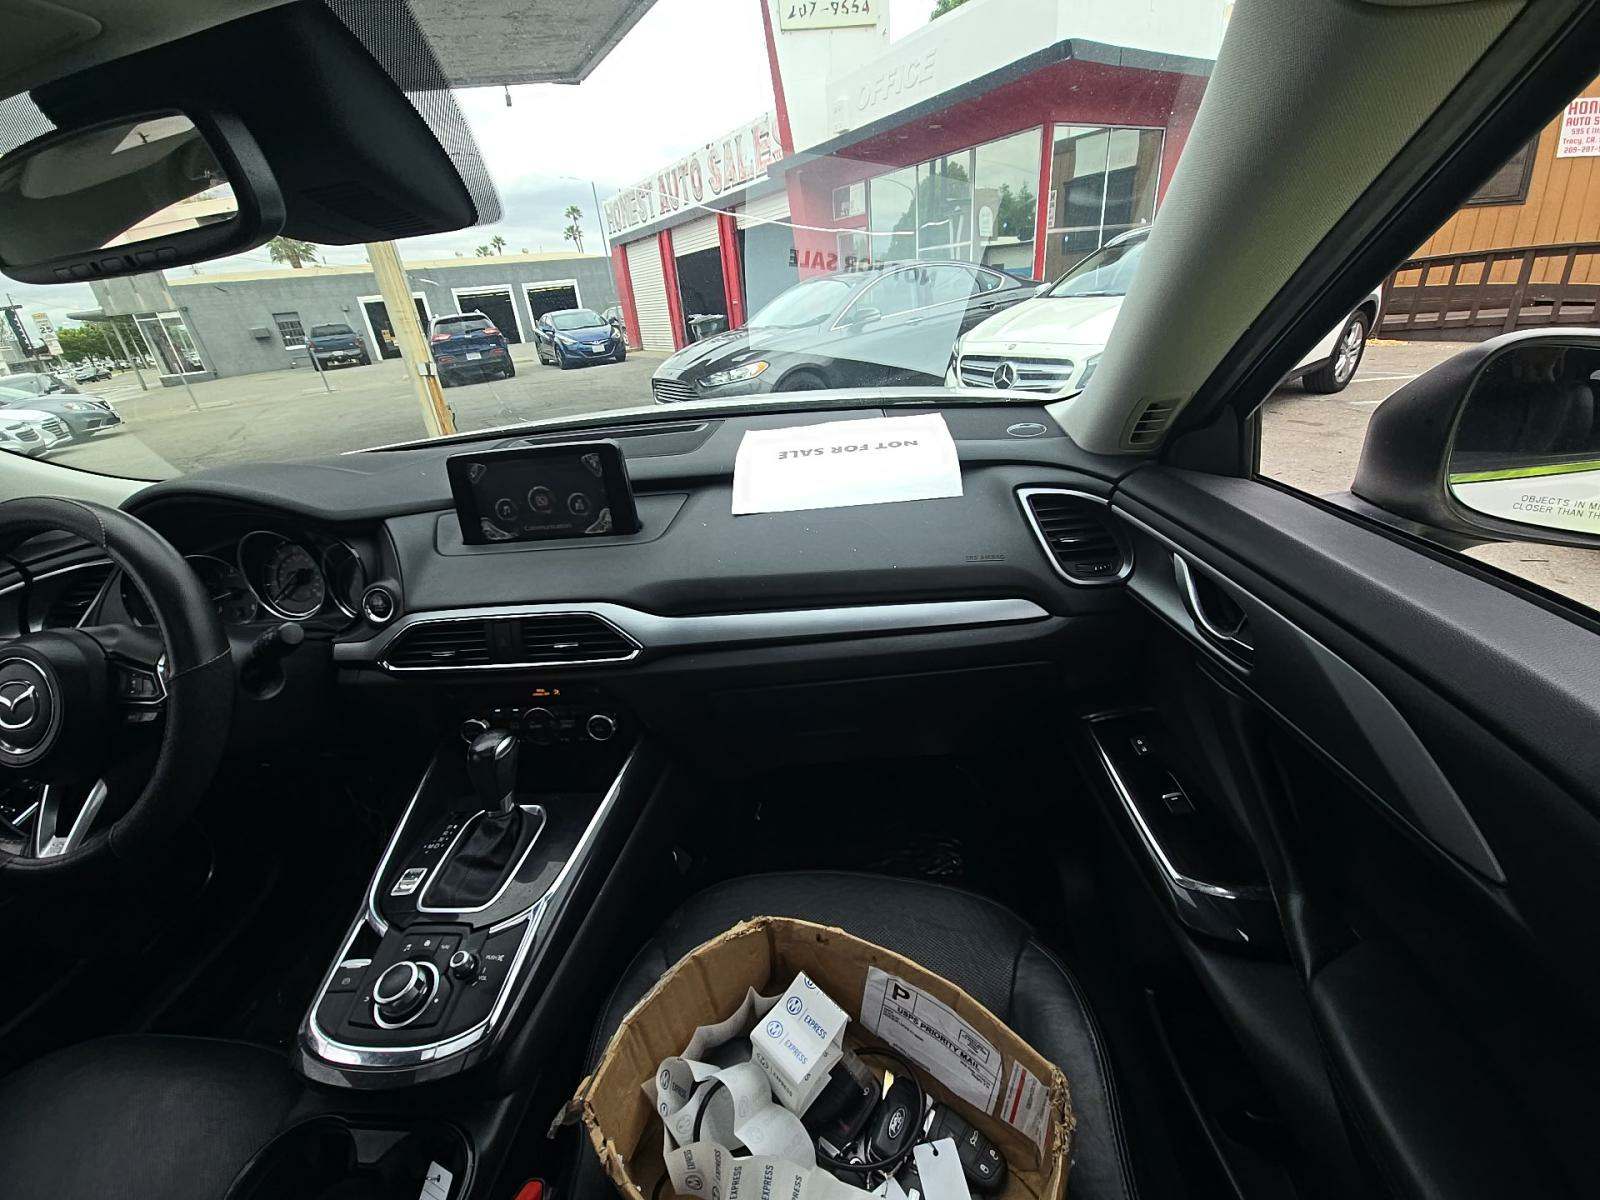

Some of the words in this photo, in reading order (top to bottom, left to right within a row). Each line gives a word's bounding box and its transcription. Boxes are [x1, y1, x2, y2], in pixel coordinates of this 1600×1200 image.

[857, 49, 937, 111] OFFICE
[1568, 100, 1600, 115] HON
[1566, 116, 1591, 127] AUTO
[604, 181, 656, 235] HONEST
[657, 157, 704, 214] AUTO
[778, 447, 824, 460] SALE
[831, 443, 869, 454] FOR
[875, 439, 919, 450] NOT
[1512, 502, 1553, 514] CLOSER
[1557, 507, 1584, 517] THAN
[1521, 494, 1570, 507] OBJECTS
[1574, 501, 1586, 509] IN
[892, 982, 910, 1001] P
[803, 1014, 828, 1040] EXPRESS
[897, 1006, 919, 1026] USPS
[920, 1023, 961, 1053] PRIORITY
[960, 1051, 981, 1071] MAIL
[784, 1039, 809, 1065] EXPRESS
[729, 1165, 743, 1200] EXPRESS
[761, 1164, 774, 1200] EXPRESS
